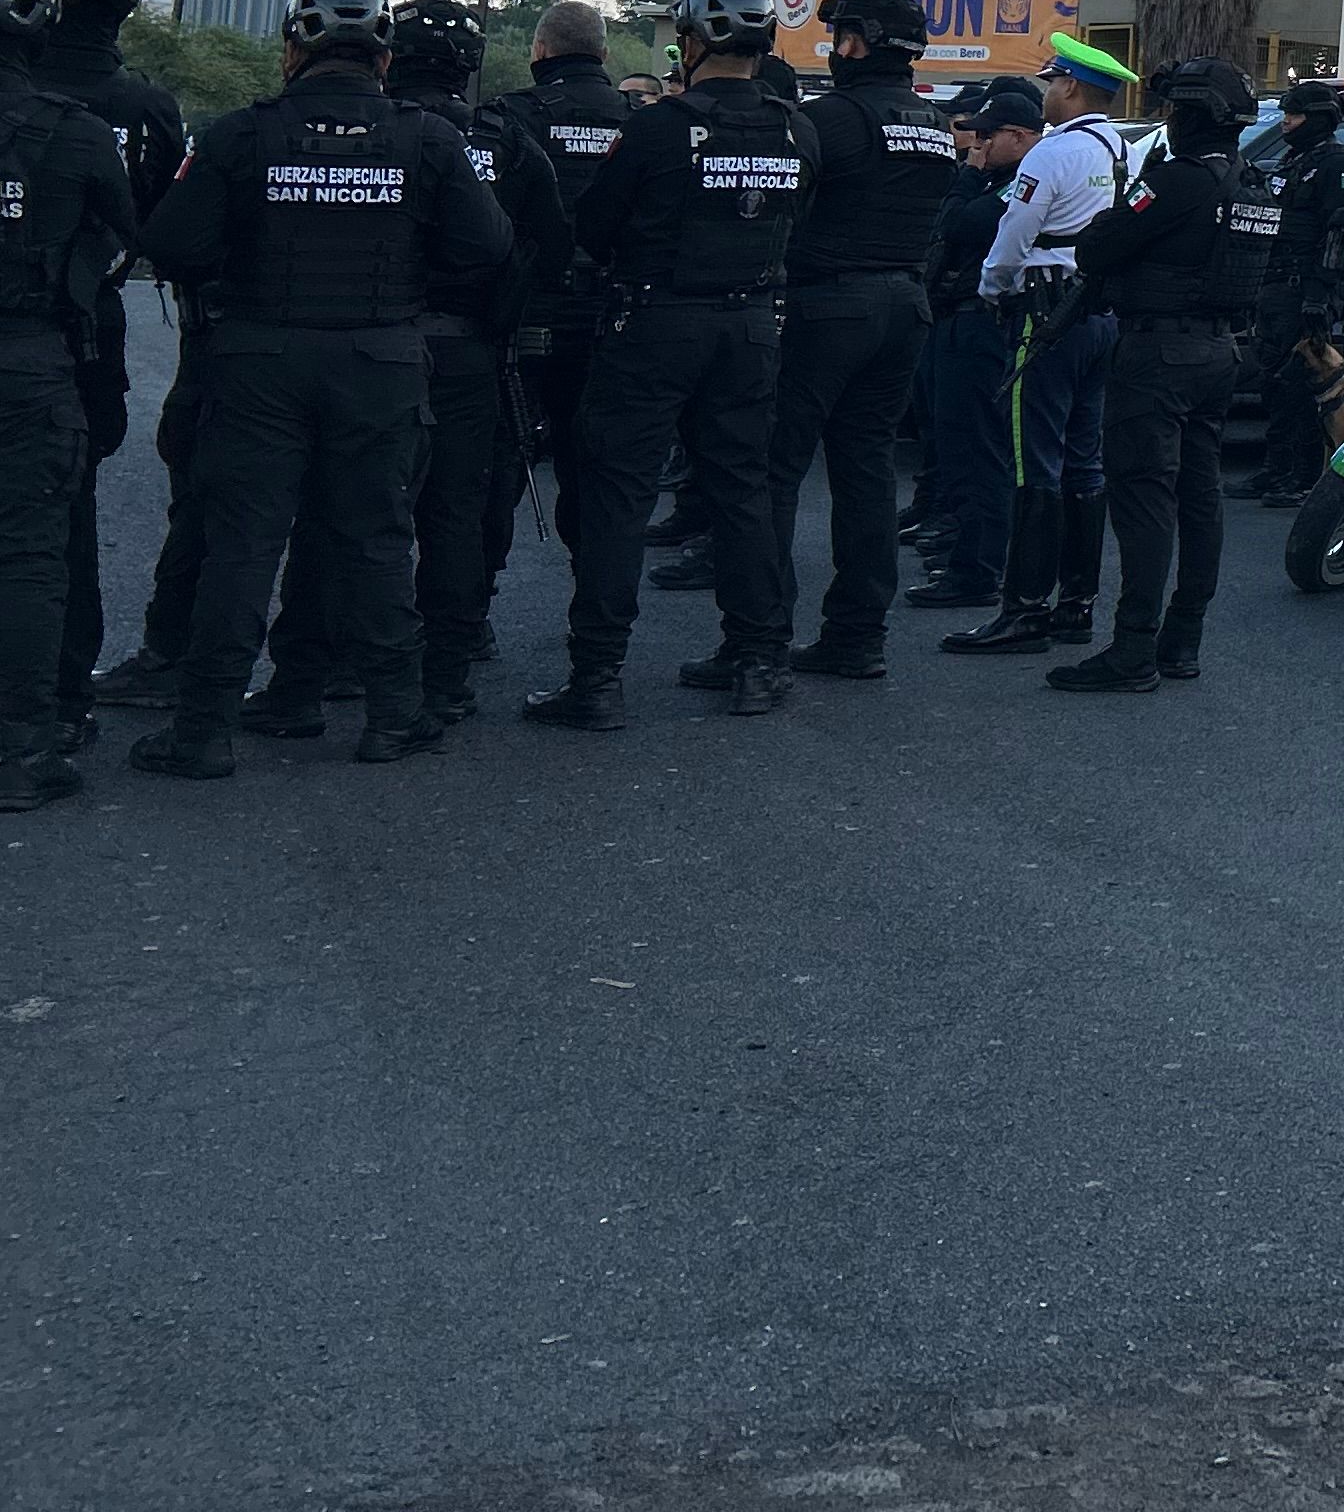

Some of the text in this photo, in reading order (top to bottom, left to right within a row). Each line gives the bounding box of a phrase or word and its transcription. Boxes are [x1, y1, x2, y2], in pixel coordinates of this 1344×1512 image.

[787, 3, 809, 22] Berel
[939, 48, 957, 59] con
[959, 47, 985, 59] Berel
[550, 125, 591, 140] FUERZAS
[565, 140, 587, 153] SAN
[887, 139, 914, 152] SAN
[703, 156, 801, 174] FUERZAS ESPECIALES
[267, 166, 404, 185] FUERZAS ESPECIALES
[703, 173, 798, 190] SAN NICOLÁS
[267, 185, 403, 203] SAN NICOLÁS
[1230, 218, 1253, 232] SAN
